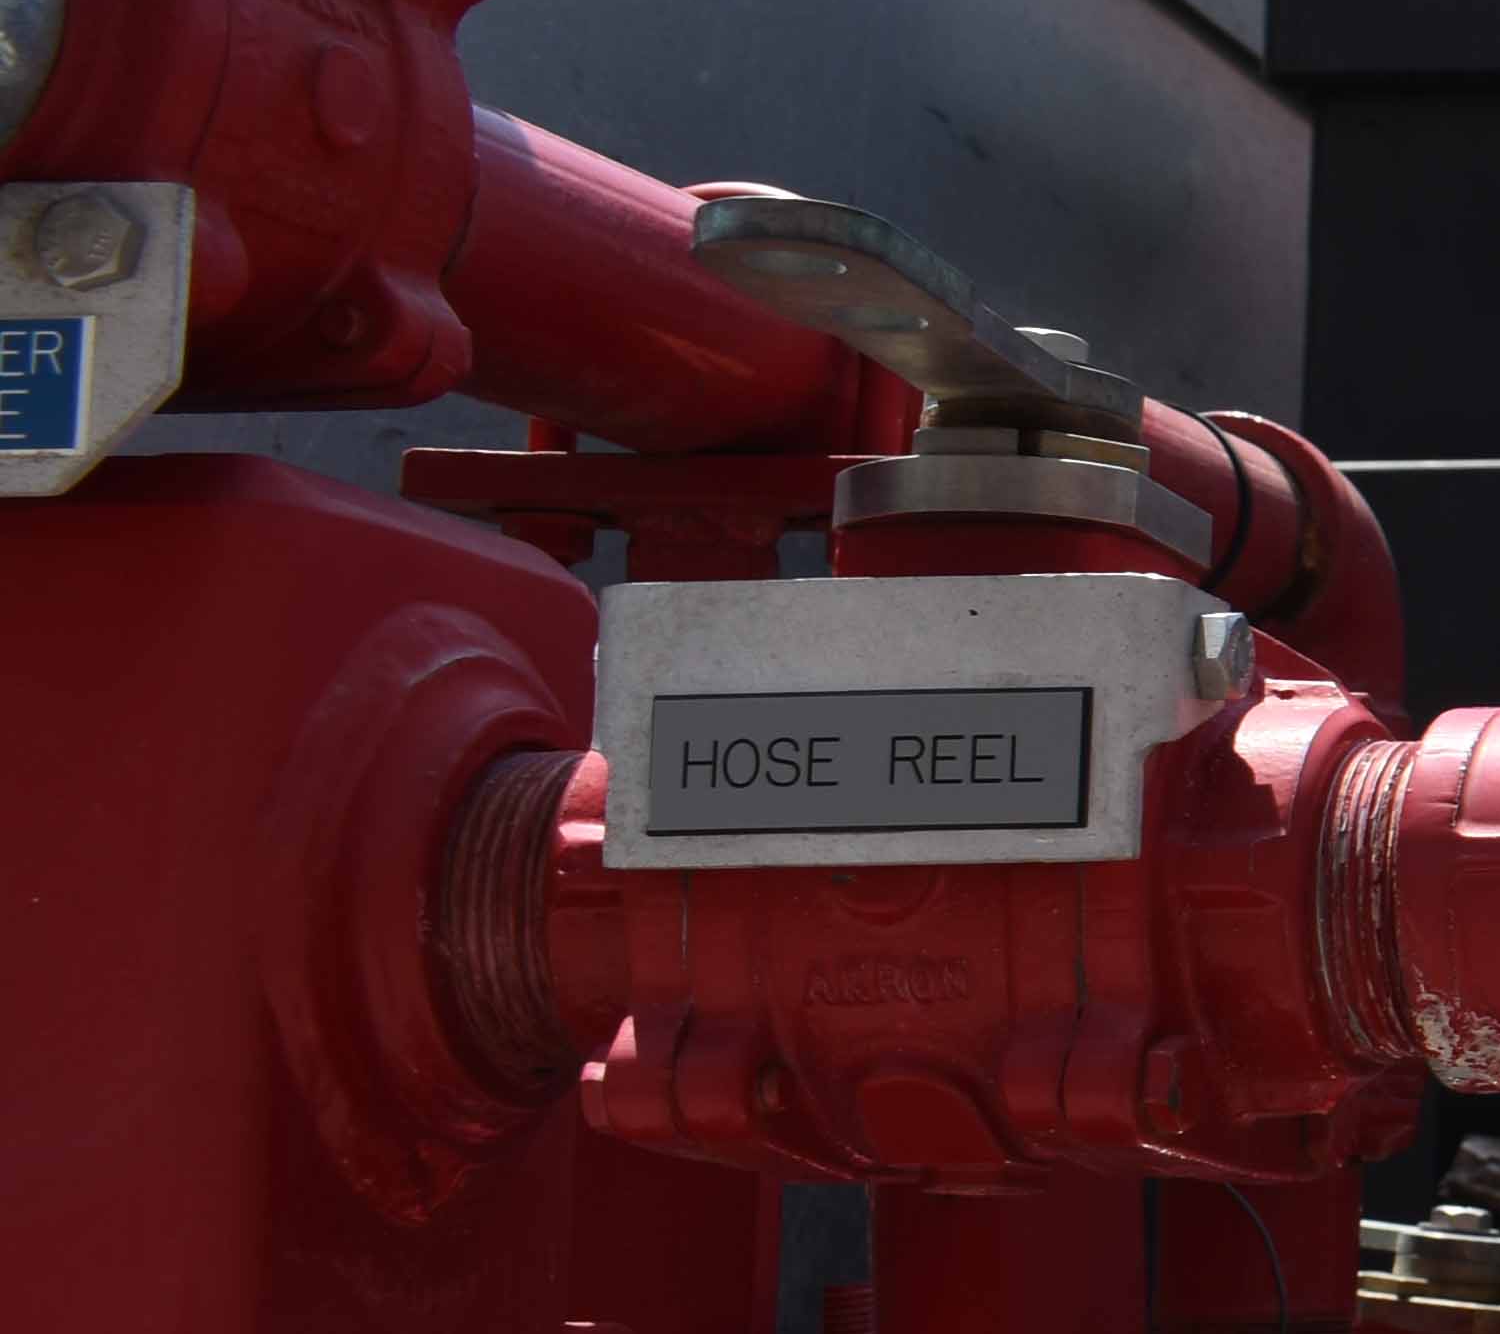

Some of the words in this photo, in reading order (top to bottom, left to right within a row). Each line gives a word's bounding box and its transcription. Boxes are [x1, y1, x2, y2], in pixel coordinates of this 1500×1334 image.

[681, 736, 841, 789] HOSE
[889, 734, 1045, 786] REEL
[803, 956, 970, 1007] AKRON
